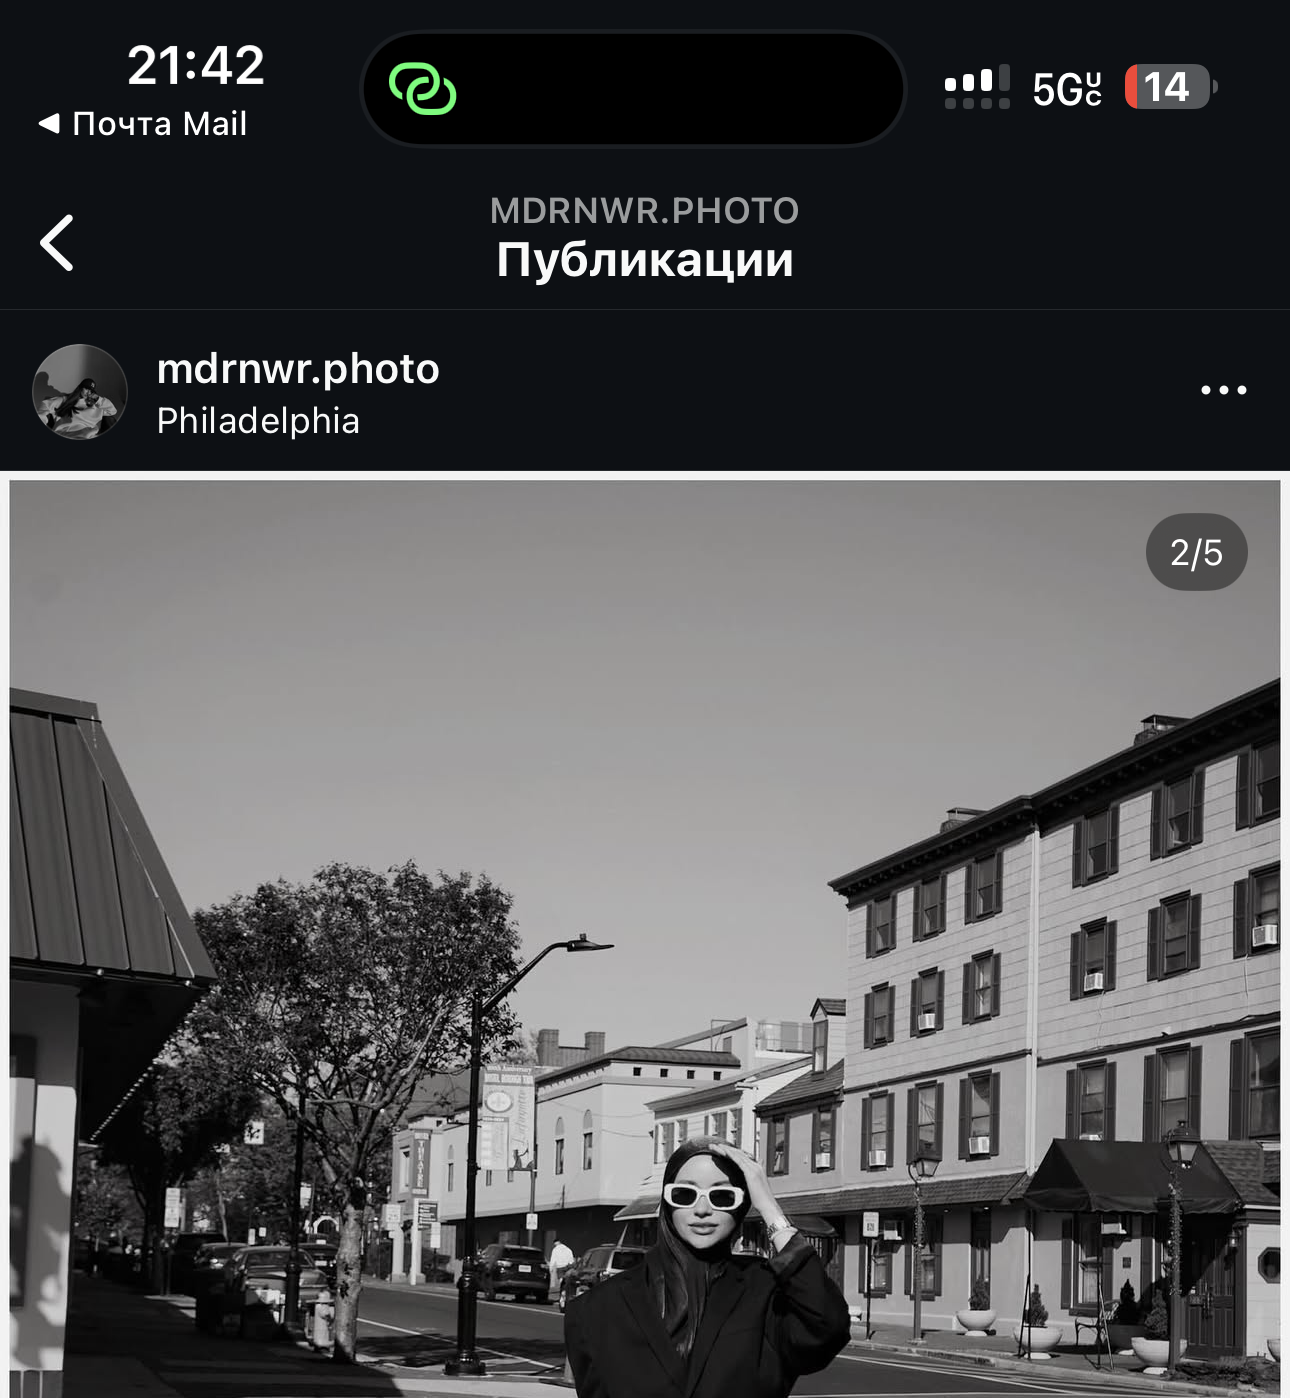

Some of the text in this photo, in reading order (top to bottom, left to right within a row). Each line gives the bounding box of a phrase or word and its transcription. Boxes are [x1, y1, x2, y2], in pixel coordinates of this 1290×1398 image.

[127, 44, 265, 85] 21:42
[1144, 71, 1190, 102] 14
[73, 109, 247, 137] Почта Mail
[491, 196, 799, 225] MDRNWR.PHOTO
[498, 239, 793, 286] Публикации
[158, 351, 440, 392] mdrnwr.photo
[158, 405, 359, 441] Philadelphia
[1170, 537, 1223, 573] 2/5
